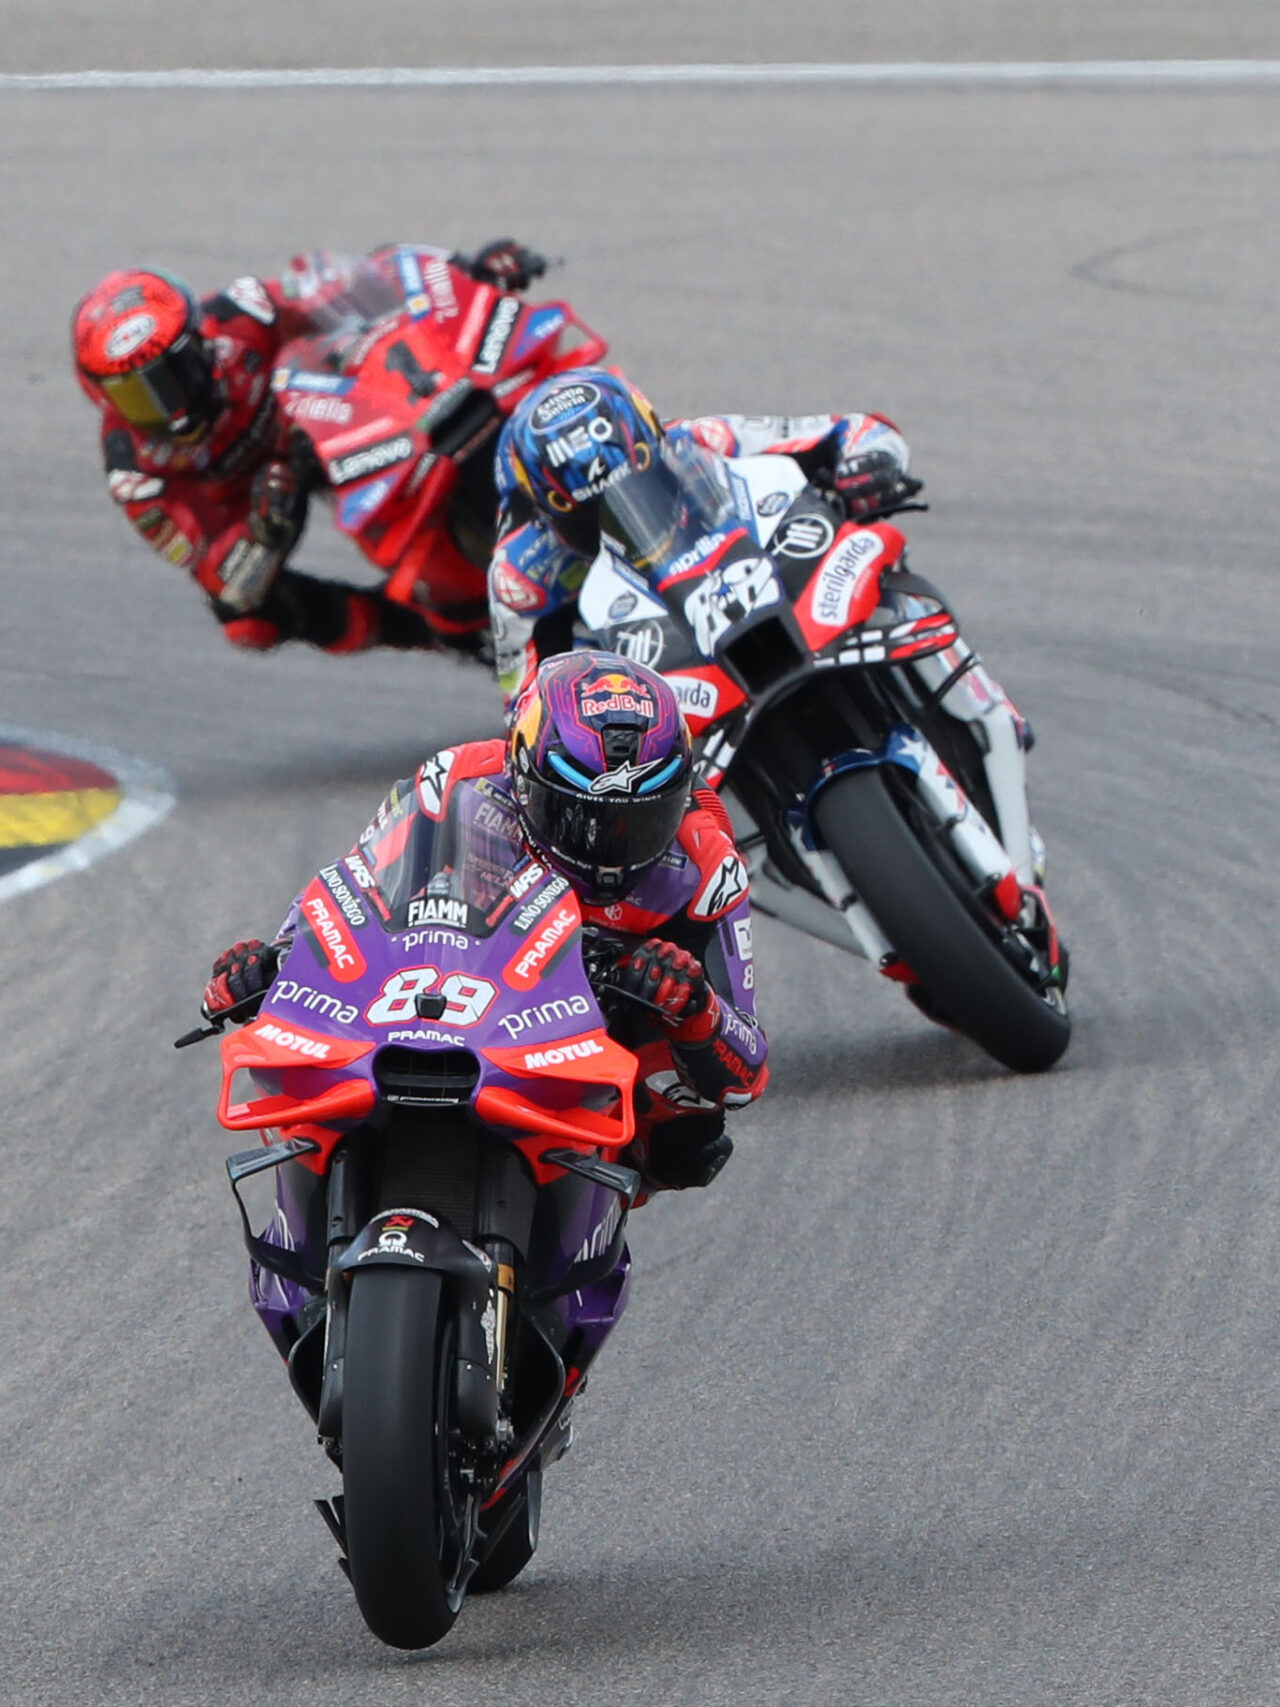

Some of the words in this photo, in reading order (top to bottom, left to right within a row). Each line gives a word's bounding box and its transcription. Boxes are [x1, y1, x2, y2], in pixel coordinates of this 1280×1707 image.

[472, 296, 519, 373] Lenovo
[572, 461, 632, 501] SHARK
[669, 532, 726, 575] aprilia
[821, 534, 875, 619] sterilgarda
[581, 694, 620, 716] Red
[620, 695, 654, 718] Bull
[344, 855, 376, 889] WRS
[510, 863, 544, 898] WRS
[408, 899, 468, 928] FIAMM
[306, 897, 355, 970] PRAMAC
[402, 930, 469, 952] prima
[514, 908, 577, 978] PRAMAC
[271, 980, 359, 1025] prima
[363, 965, 500, 1029] 89
[498, 995, 590, 1040] prima
[254, 1023, 331, 1059] MOTUL
[388, 1030, 466, 1047] PRAMAC
[524, 1039, 605, 1070] MOTUL
[358, 1244, 425, 1263] PRAMAC
